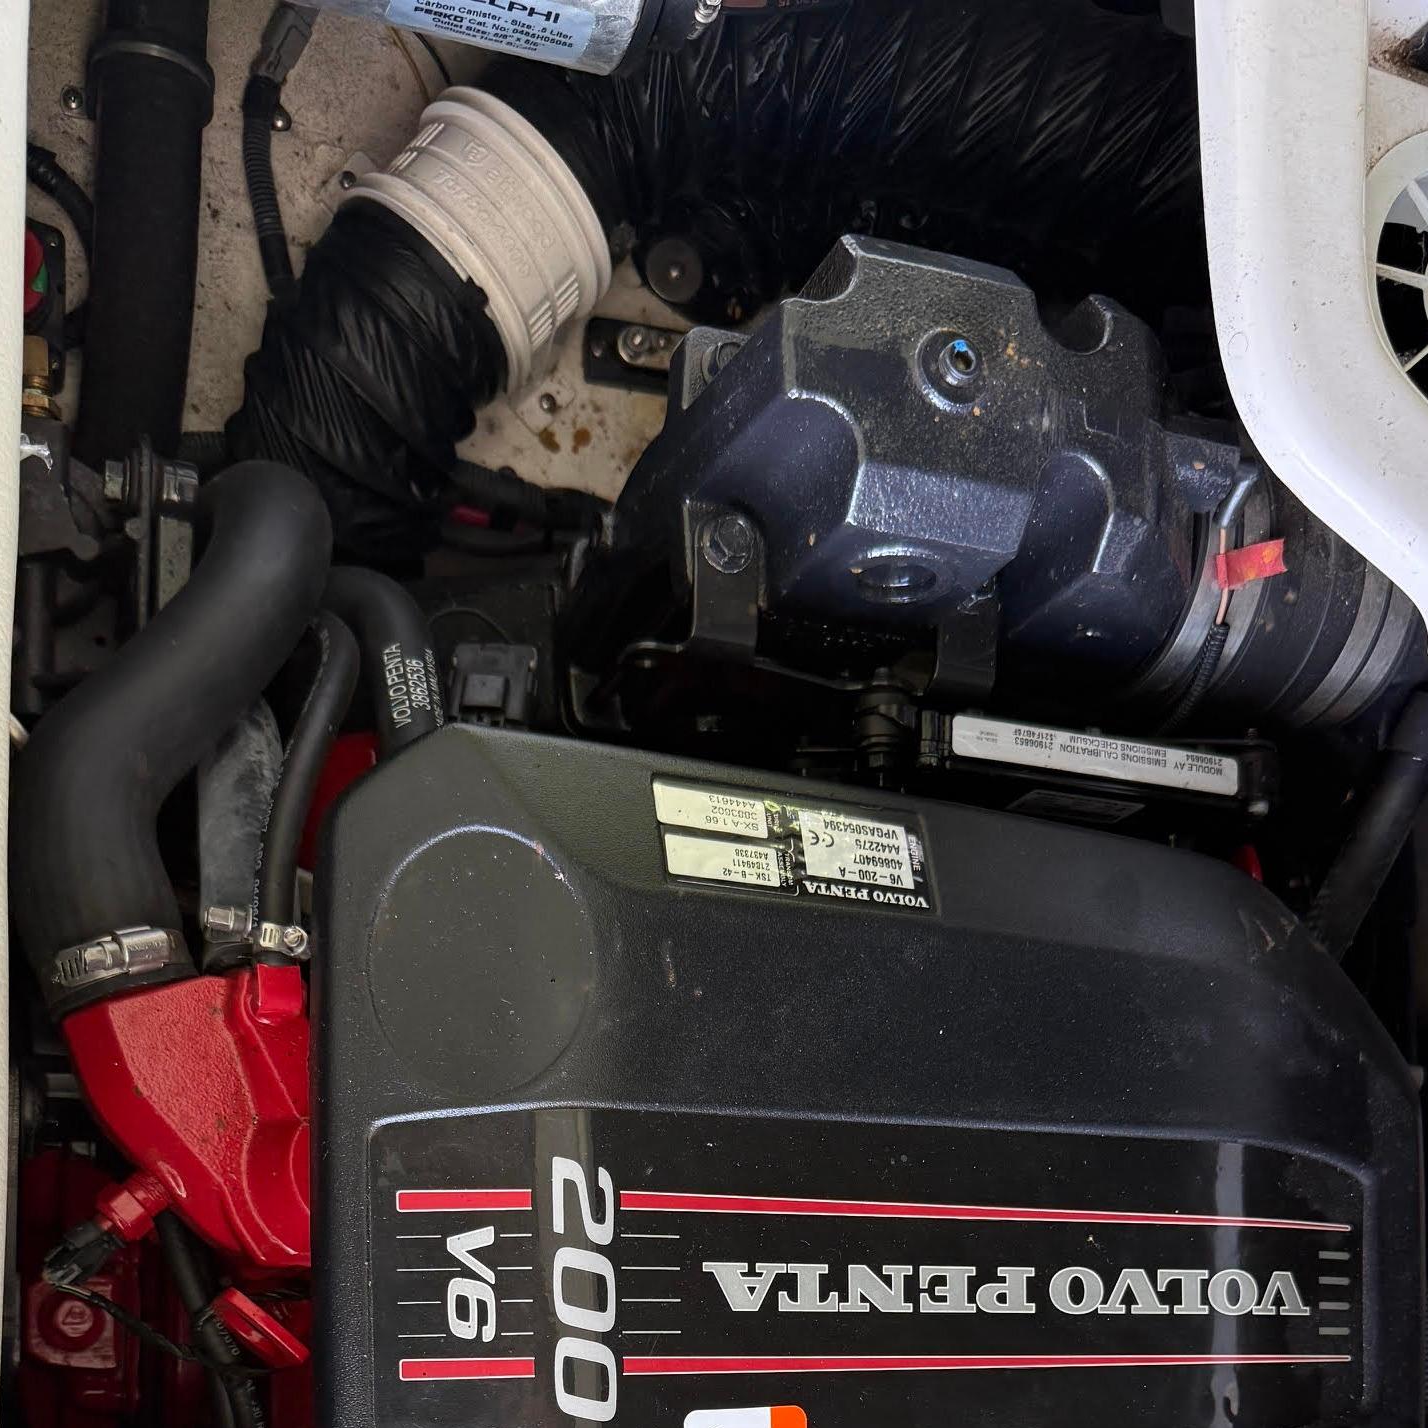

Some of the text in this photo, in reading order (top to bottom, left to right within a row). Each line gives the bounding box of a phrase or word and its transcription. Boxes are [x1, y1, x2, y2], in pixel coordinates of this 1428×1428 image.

[417, 0, 456, 13] Carbon
[458, 7, 502, 22] Canister
[511, 19, 536, 32] Size:
[468, 18, 489, 29] Cat.
[491, 22, 510, 33] No:
[383, 643, 412, 729] VOLVO PENTA
[405, 659, 431, 711] 3862536
[1059, 743, 1167, 768] EMISSIONS CALIBRATION
[1069, 735, 1119, 751] CHECKSUM
[1187, 762, 1223, 777] MODULE
[823, 819, 899, 840] VPGAS054394
[855, 838, 900, 855] A442275
[853, 853, 903, 871] 40869407
[802, 880, 930, 909] VOLVO PENTA
[446, 1226, 496, 1342] V6
[552, 1156, 617, 1422] 200
[702, 1262, 1310, 1316] VOLVO PENTA
